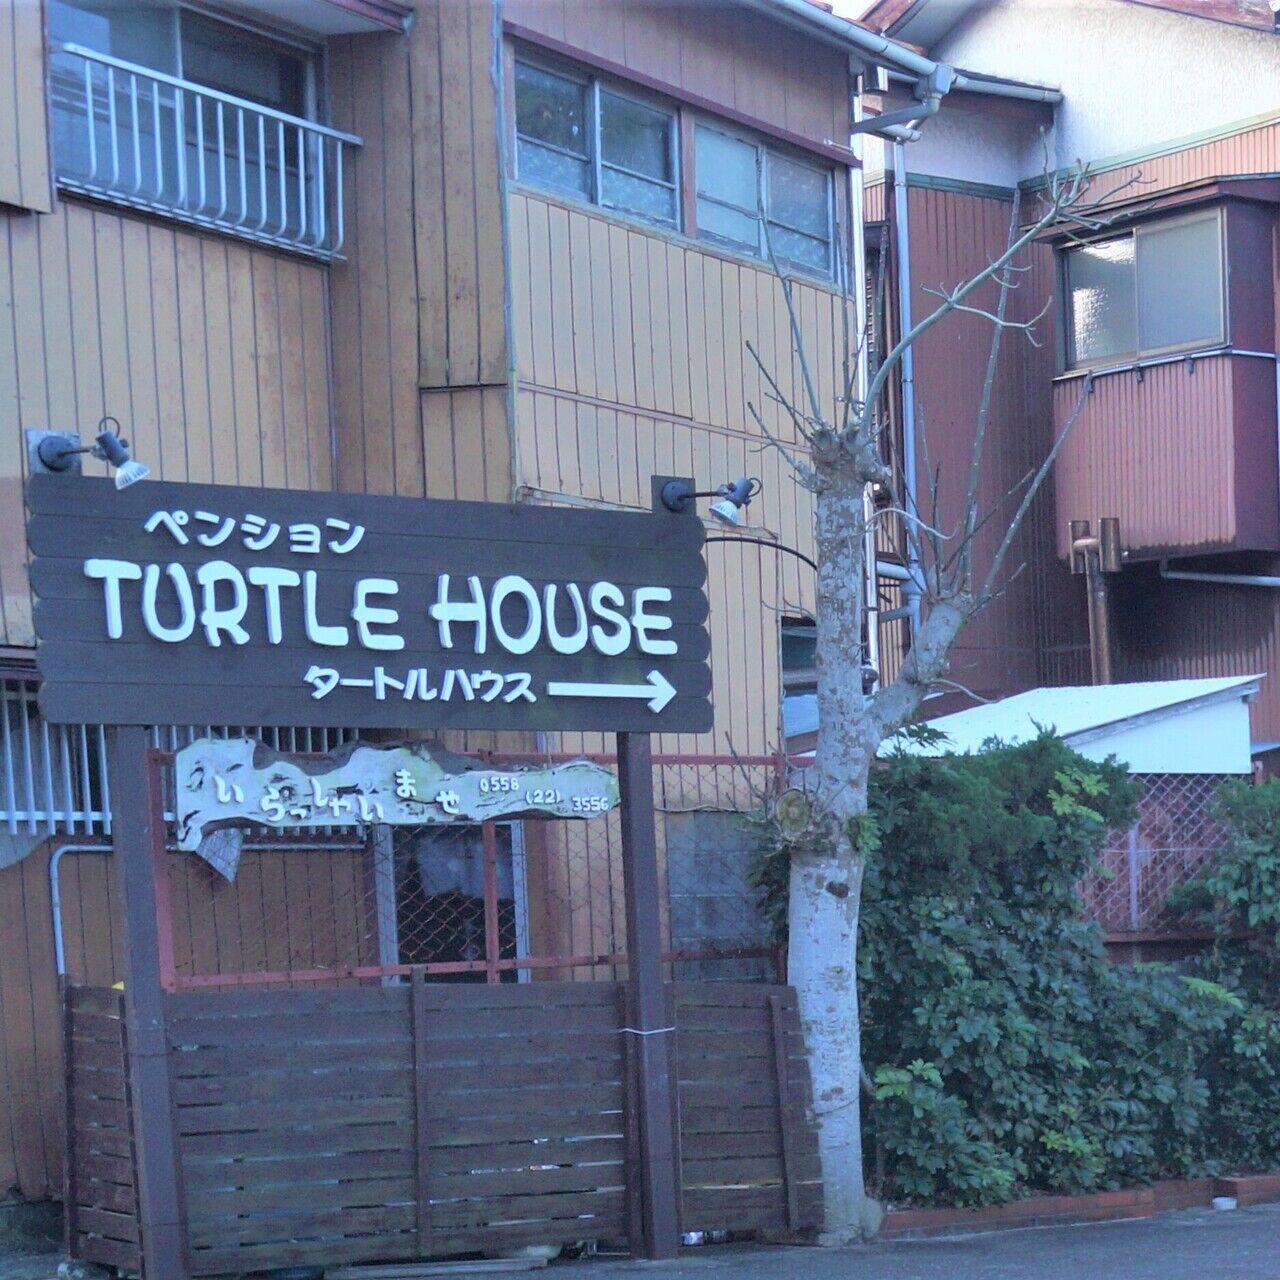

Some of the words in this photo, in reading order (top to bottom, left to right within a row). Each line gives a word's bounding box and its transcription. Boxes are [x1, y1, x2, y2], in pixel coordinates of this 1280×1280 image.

[145, 510, 365, 554] ペンション
[84, 559, 405, 651] TURTLE
[429, 574, 679, 656] HOUSE
[304, 665, 538, 703] タートルハウス
[479, 775, 520, 794] 0558
[526, 788, 562, 806] (22)
[572, 795, 609, 813] 3556
